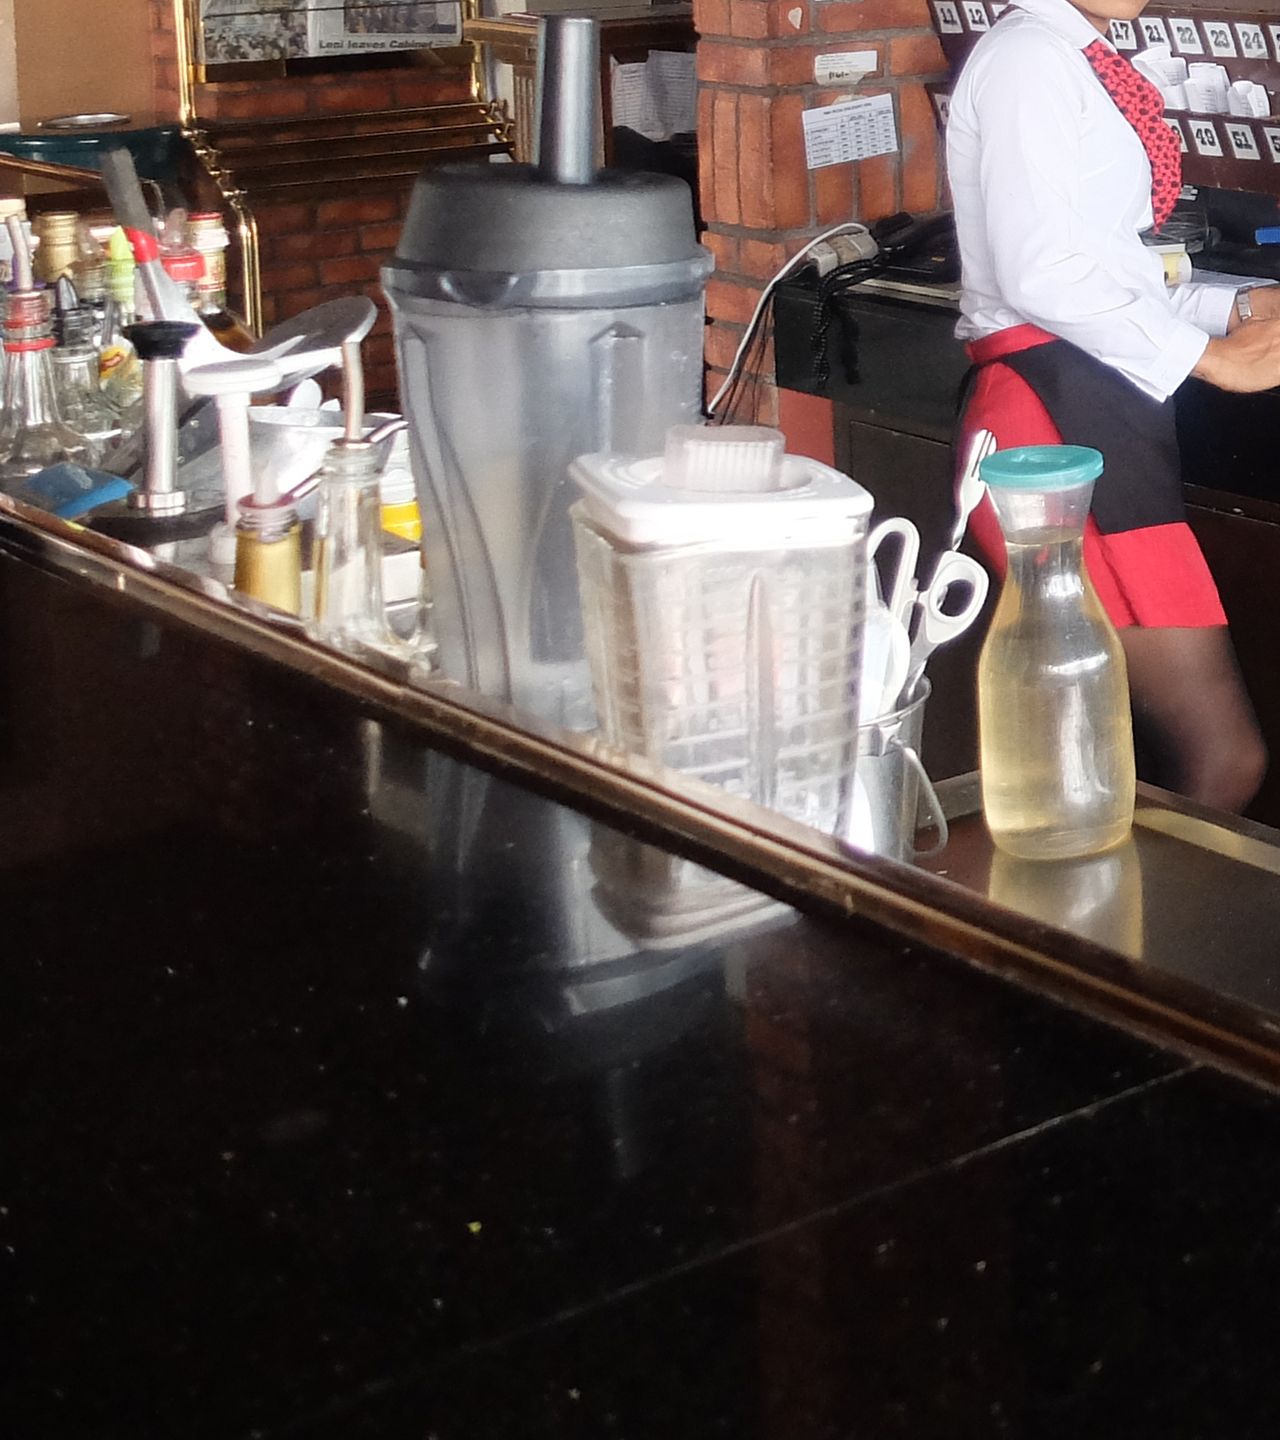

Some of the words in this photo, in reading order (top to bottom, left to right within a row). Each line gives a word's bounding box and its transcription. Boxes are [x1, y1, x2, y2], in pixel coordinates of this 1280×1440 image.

[942, 7, 958, 25] 11
[969, 7, 985, 24] 12
[1112, 21, 1131, 41] 17
[1145, 24, 1165, 44] 21
[1177, 26, 1194, 45] 22
[1210, 29, 1229, 48] 23
[1241, 31, 1263, 49] 24
[347, 39, 386, 50] leaves
[389, 38, 433, 50] Cabinet
[1195, 128, 1216, 146] 49
[1232, 131, 1253, 150] 51
